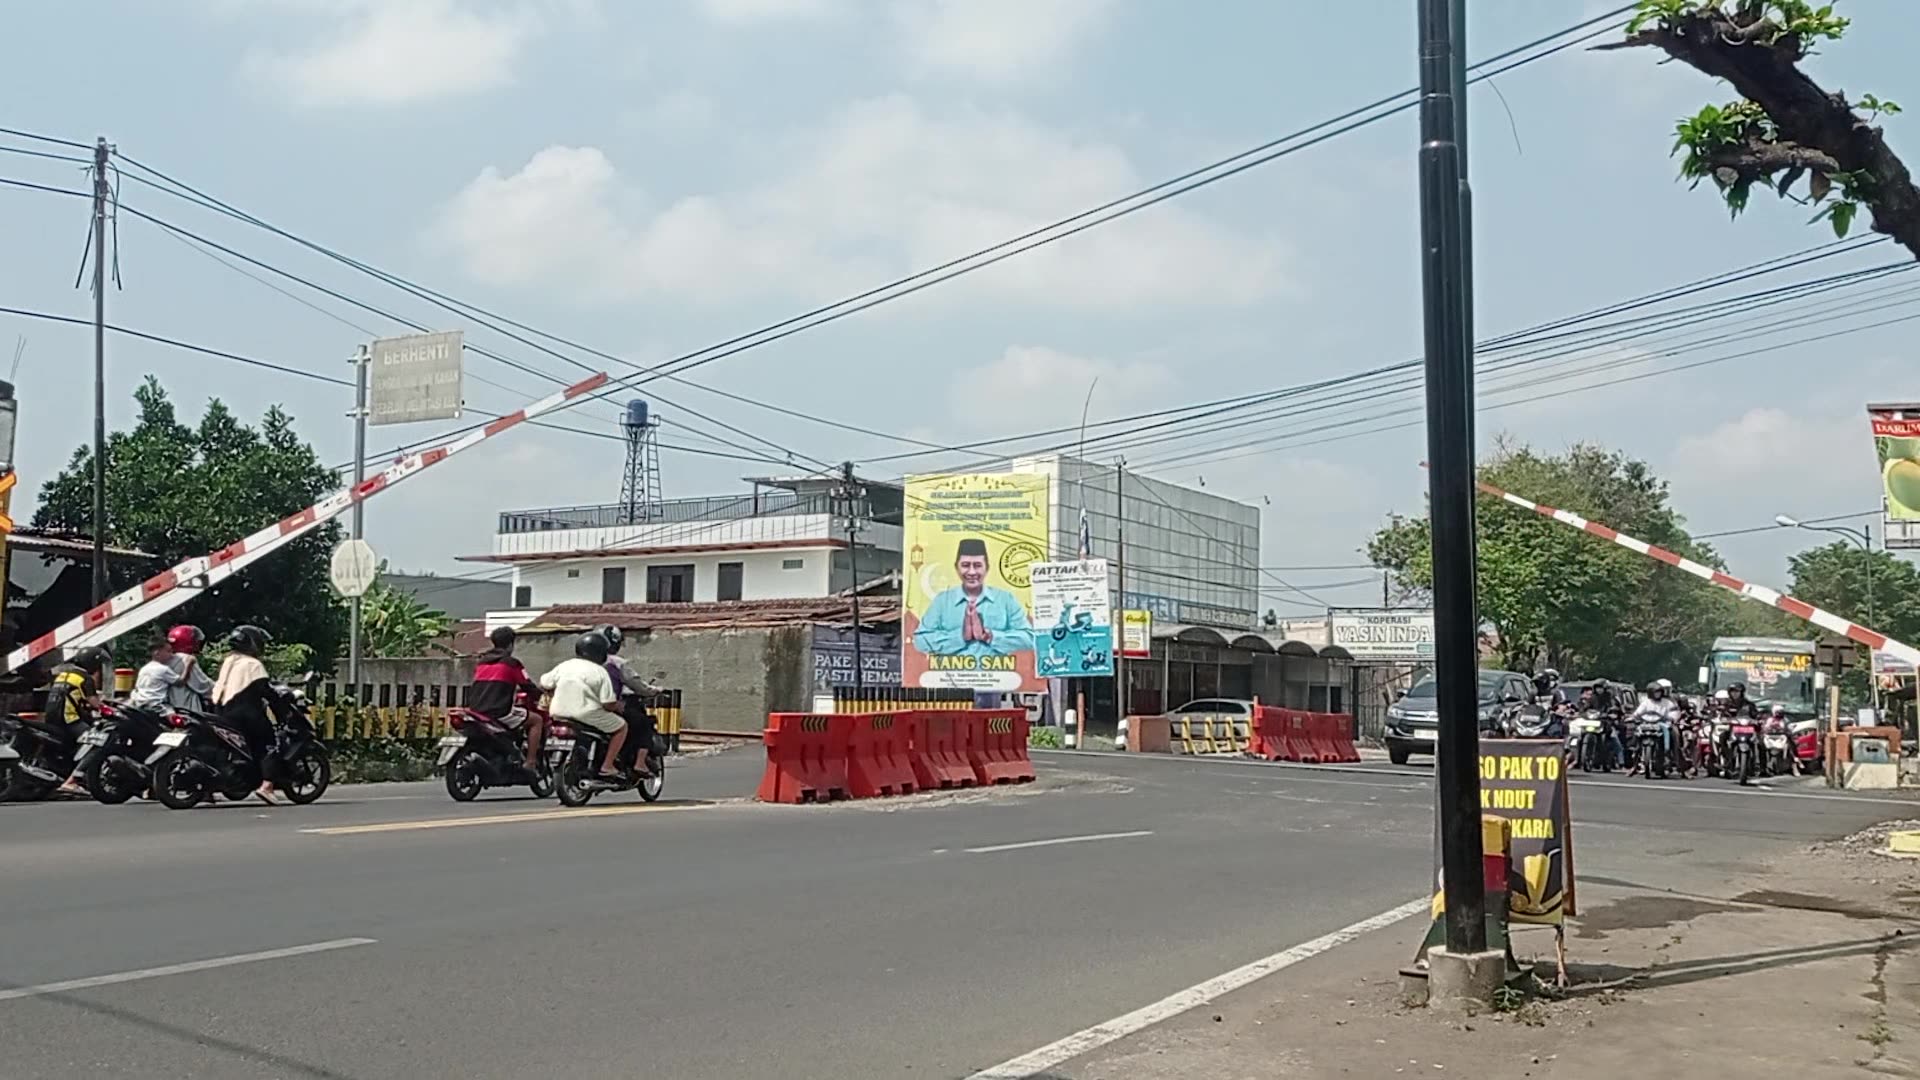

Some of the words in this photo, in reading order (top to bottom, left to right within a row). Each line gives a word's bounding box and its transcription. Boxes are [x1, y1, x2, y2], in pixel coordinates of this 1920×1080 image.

[384, 343, 449, 365] BERHENTI
[1032, 565, 1079, 576] FATTAH
[1367, 616, 1412, 624] KOPERASI
[1336, 625, 1387, 643] YASIN
[814, 654, 852, 668] PAKE
[929, 655, 976, 671] KANG
[980, 655, 1016, 671] SAN
[1790, 655, 1811, 669] AC
[814, 669, 855, 681] PASTI
[1499, 755, 1533, 780] PAK
[1535, 755, 1559, 781] TO
[1493, 789, 1537, 810] NDUT
[1511, 818, 1554, 839] KARA
